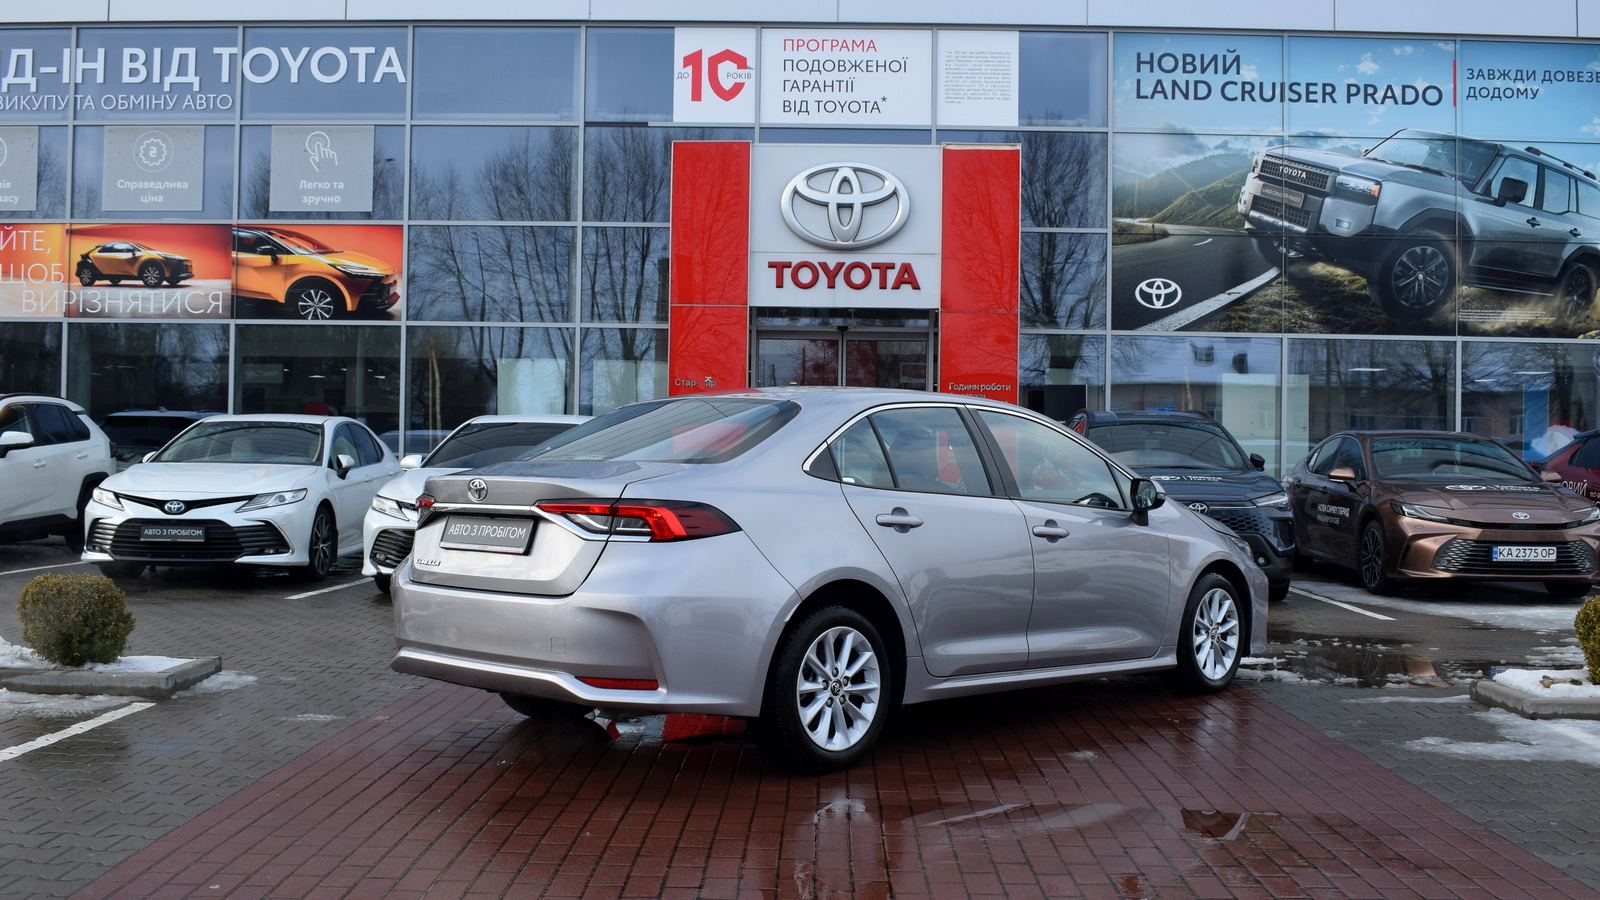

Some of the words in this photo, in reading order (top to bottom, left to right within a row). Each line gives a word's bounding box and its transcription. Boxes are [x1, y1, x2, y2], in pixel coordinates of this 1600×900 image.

[783, 39, 877, 52] ПРОГРАМА
[122, 48, 199, 91] ВІД
[213, 46, 406, 84] TOYOTA
[783, 57, 908, 74] ПОДОВЖЕНОЇ
[1136, 49, 1241, 75] НОВИЙ
[683, 48, 747, 102] 10
[1466, 68, 1536, 83] ЗАВЖДИ
[783, 78, 855, 93] ГАРАНТІЇ
[1136, 79, 1212, 102] LAND
[1220, 80, 1336, 104] CRUISER
[1346, 83, 1443, 106] PRADO
[1466, 86, 1539, 101] ДОДОМУ
[75, 95, 95, 109] ТА
[101, 94, 178, 110] ОБМІНУ
[183, 94, 233, 109] АВТО
[783, 100, 810, 116] ВІД
[1280, 166, 1306, 178] TOYOTA
[117, 179, 188, 191] Справедлива
[299, 180, 330, 191] Легко
[333, 182, 344, 190] та
[0, 195, 19, 205] асу
[141, 194, 163, 204] ціна
[301, 195, 341, 205] зручно
[0, 226, 51, 254] ЙТЕ,
[0, 263, 64, 288] ЩОБ
[768, 261, 921, 290] TOYOTA
[22, 289, 223, 314] ВИРІЗНЯТИСЯ
[980, 383, 1011, 392] роботи
[1561, 479, 1588, 496] ОВИЙ
[448, 524, 471, 535] АВТО
[478, 525, 526, 539] ПРОБІГОМ
[1498, 548, 1513, 558] KA
[1515, 548, 1539, 558] 2375
